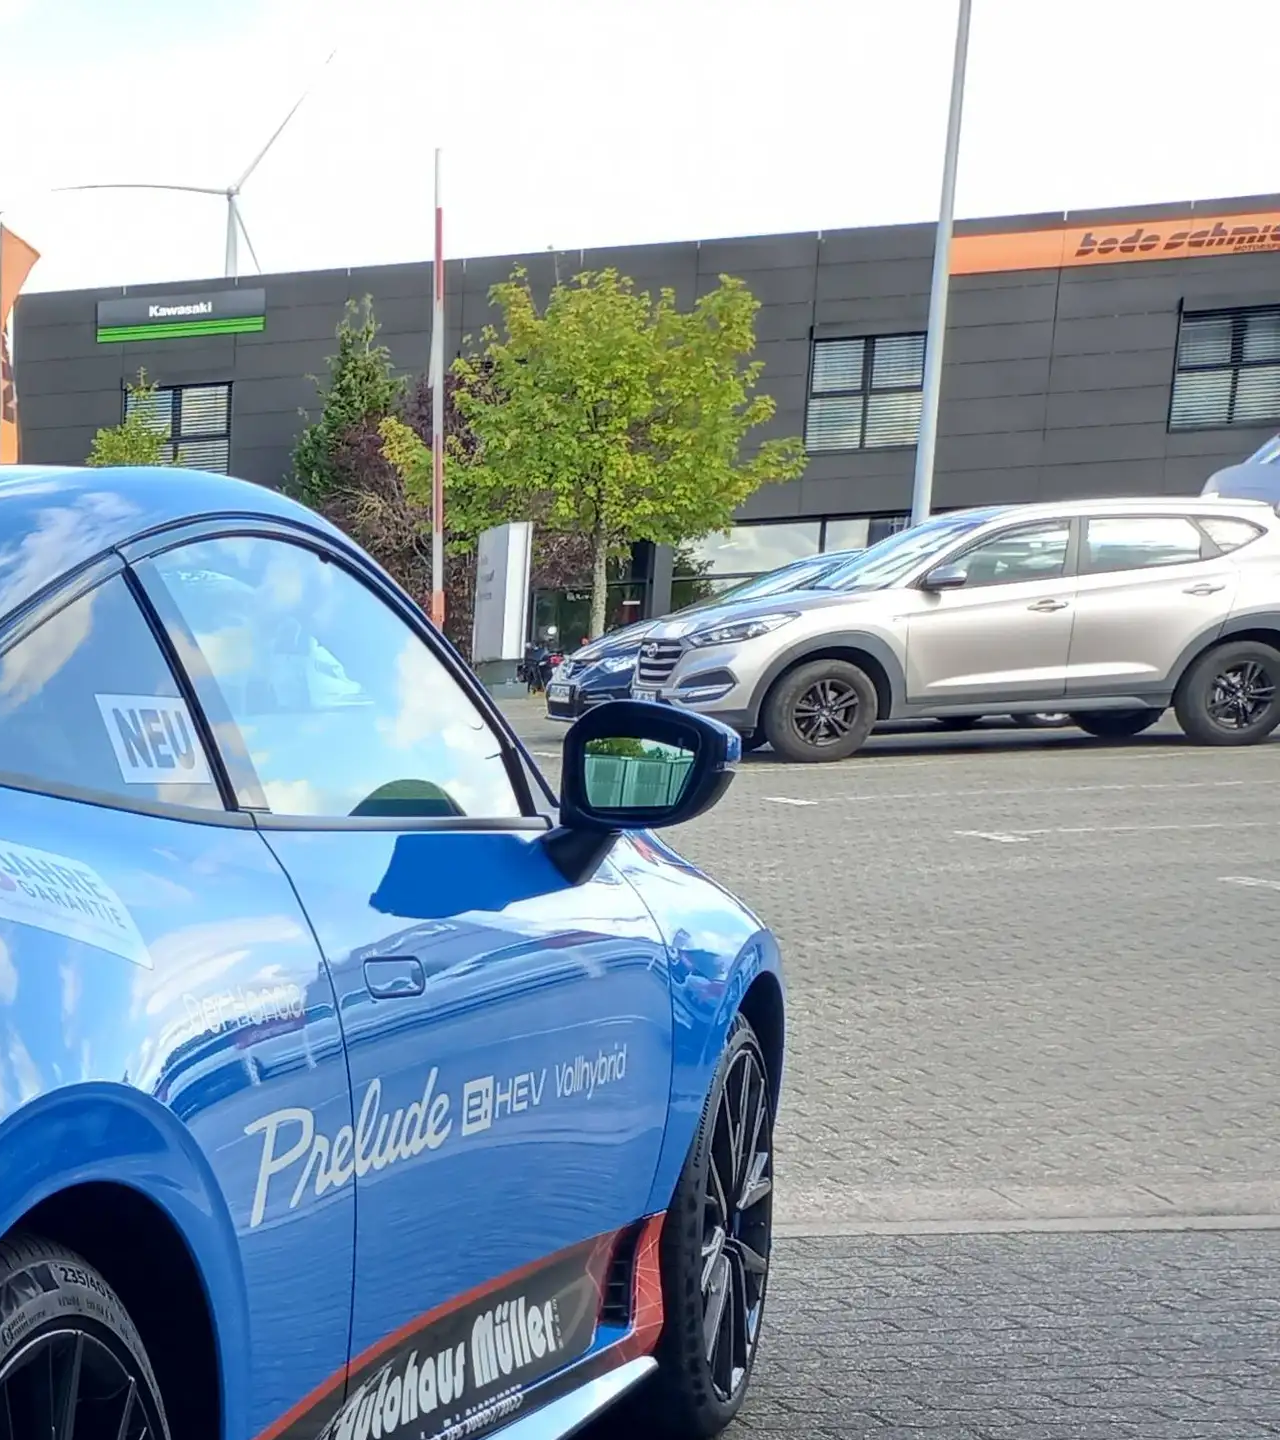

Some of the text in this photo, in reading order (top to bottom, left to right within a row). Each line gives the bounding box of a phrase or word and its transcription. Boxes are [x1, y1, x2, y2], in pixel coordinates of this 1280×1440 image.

[1075, 228, 1161, 257] bodo
[148, 301, 213, 318] Kawasaki
[112, 707, 196, 770] NEU
[16, 879, 127, 930] GARANTIE
[243, 1065, 454, 1228] Prelude
[555, 1043, 628, 1101] Vollhybrid
[471, 1297, 557, 1389] Müller
